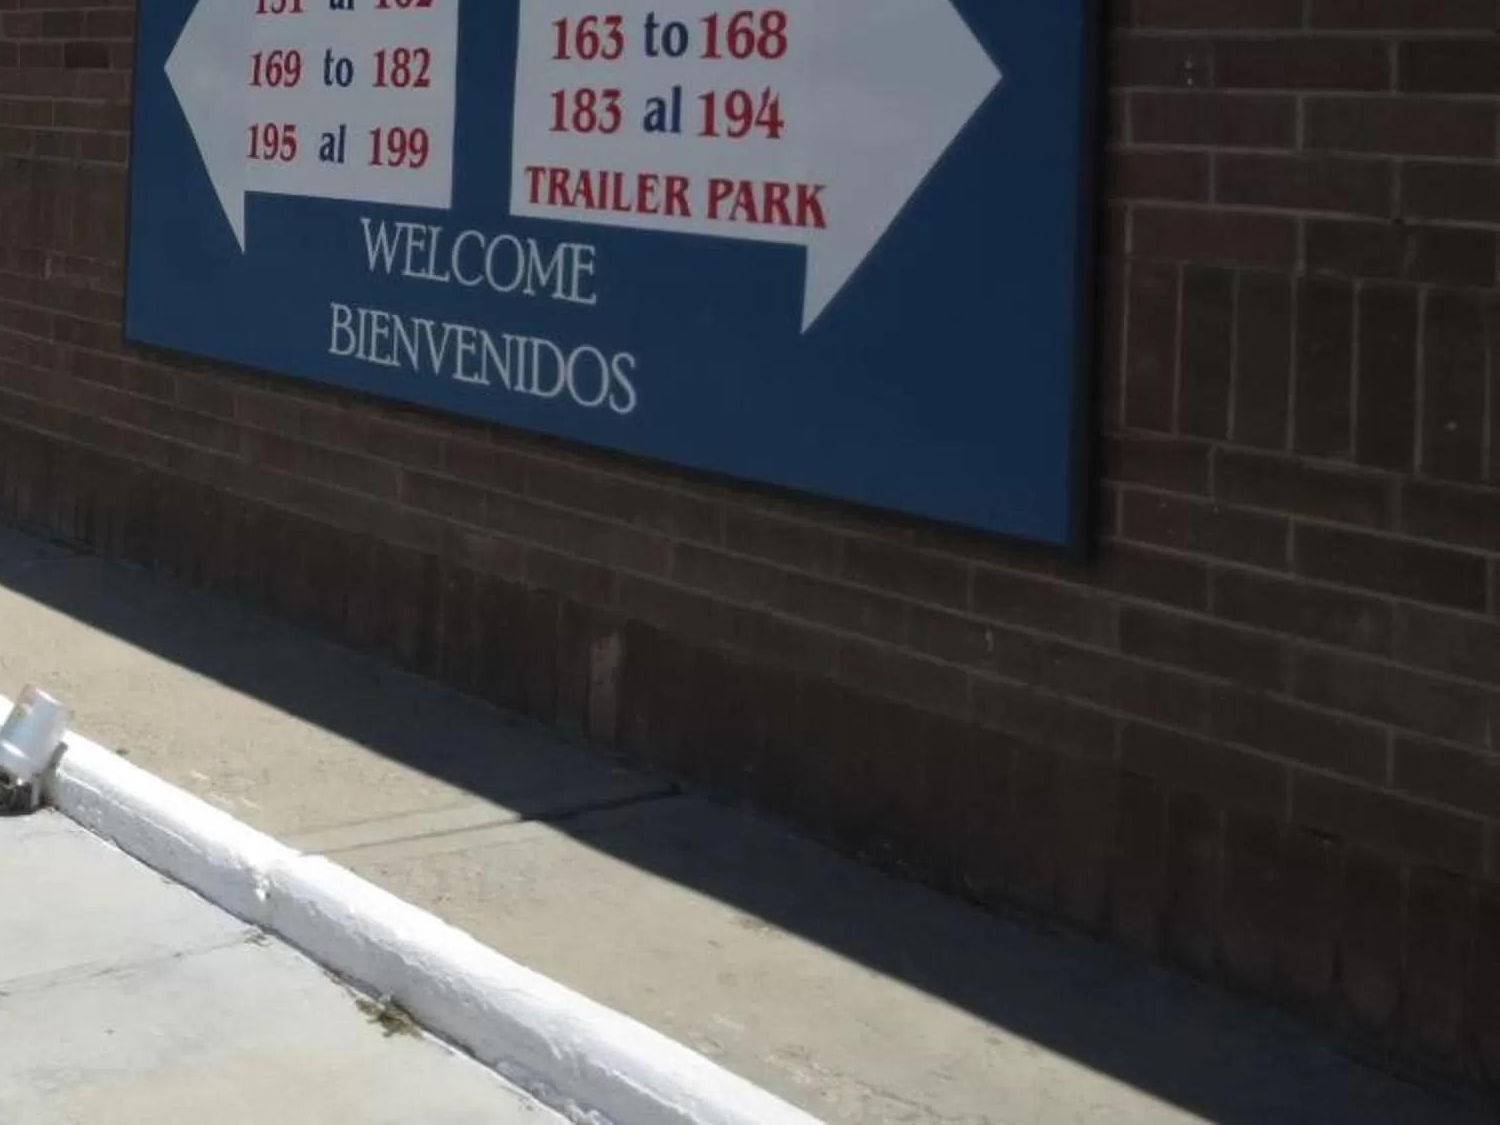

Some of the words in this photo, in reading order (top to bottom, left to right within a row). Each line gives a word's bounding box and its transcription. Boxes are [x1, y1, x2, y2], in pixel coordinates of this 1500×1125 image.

[552, 15, 624, 60] 163
[643, 11, 689, 58] to
[699, 10, 788, 60] 168
[250, 50, 302, 87] 169
[323, 48, 354, 87] to
[372, 47, 431, 88] 182
[549, 87, 622, 134] 183
[642, 84, 682, 133] al
[696, 85, 785, 139] 194
[247, 123, 297, 161] 195
[318, 124, 346, 163] al
[367, 126, 429, 169] 199
[525, 165, 692, 218] TRAILER
[706, 178, 828, 229] PARK
[360, 216, 596, 305] WELCOME
[328, 301, 637, 414] BIENVENIDOS
